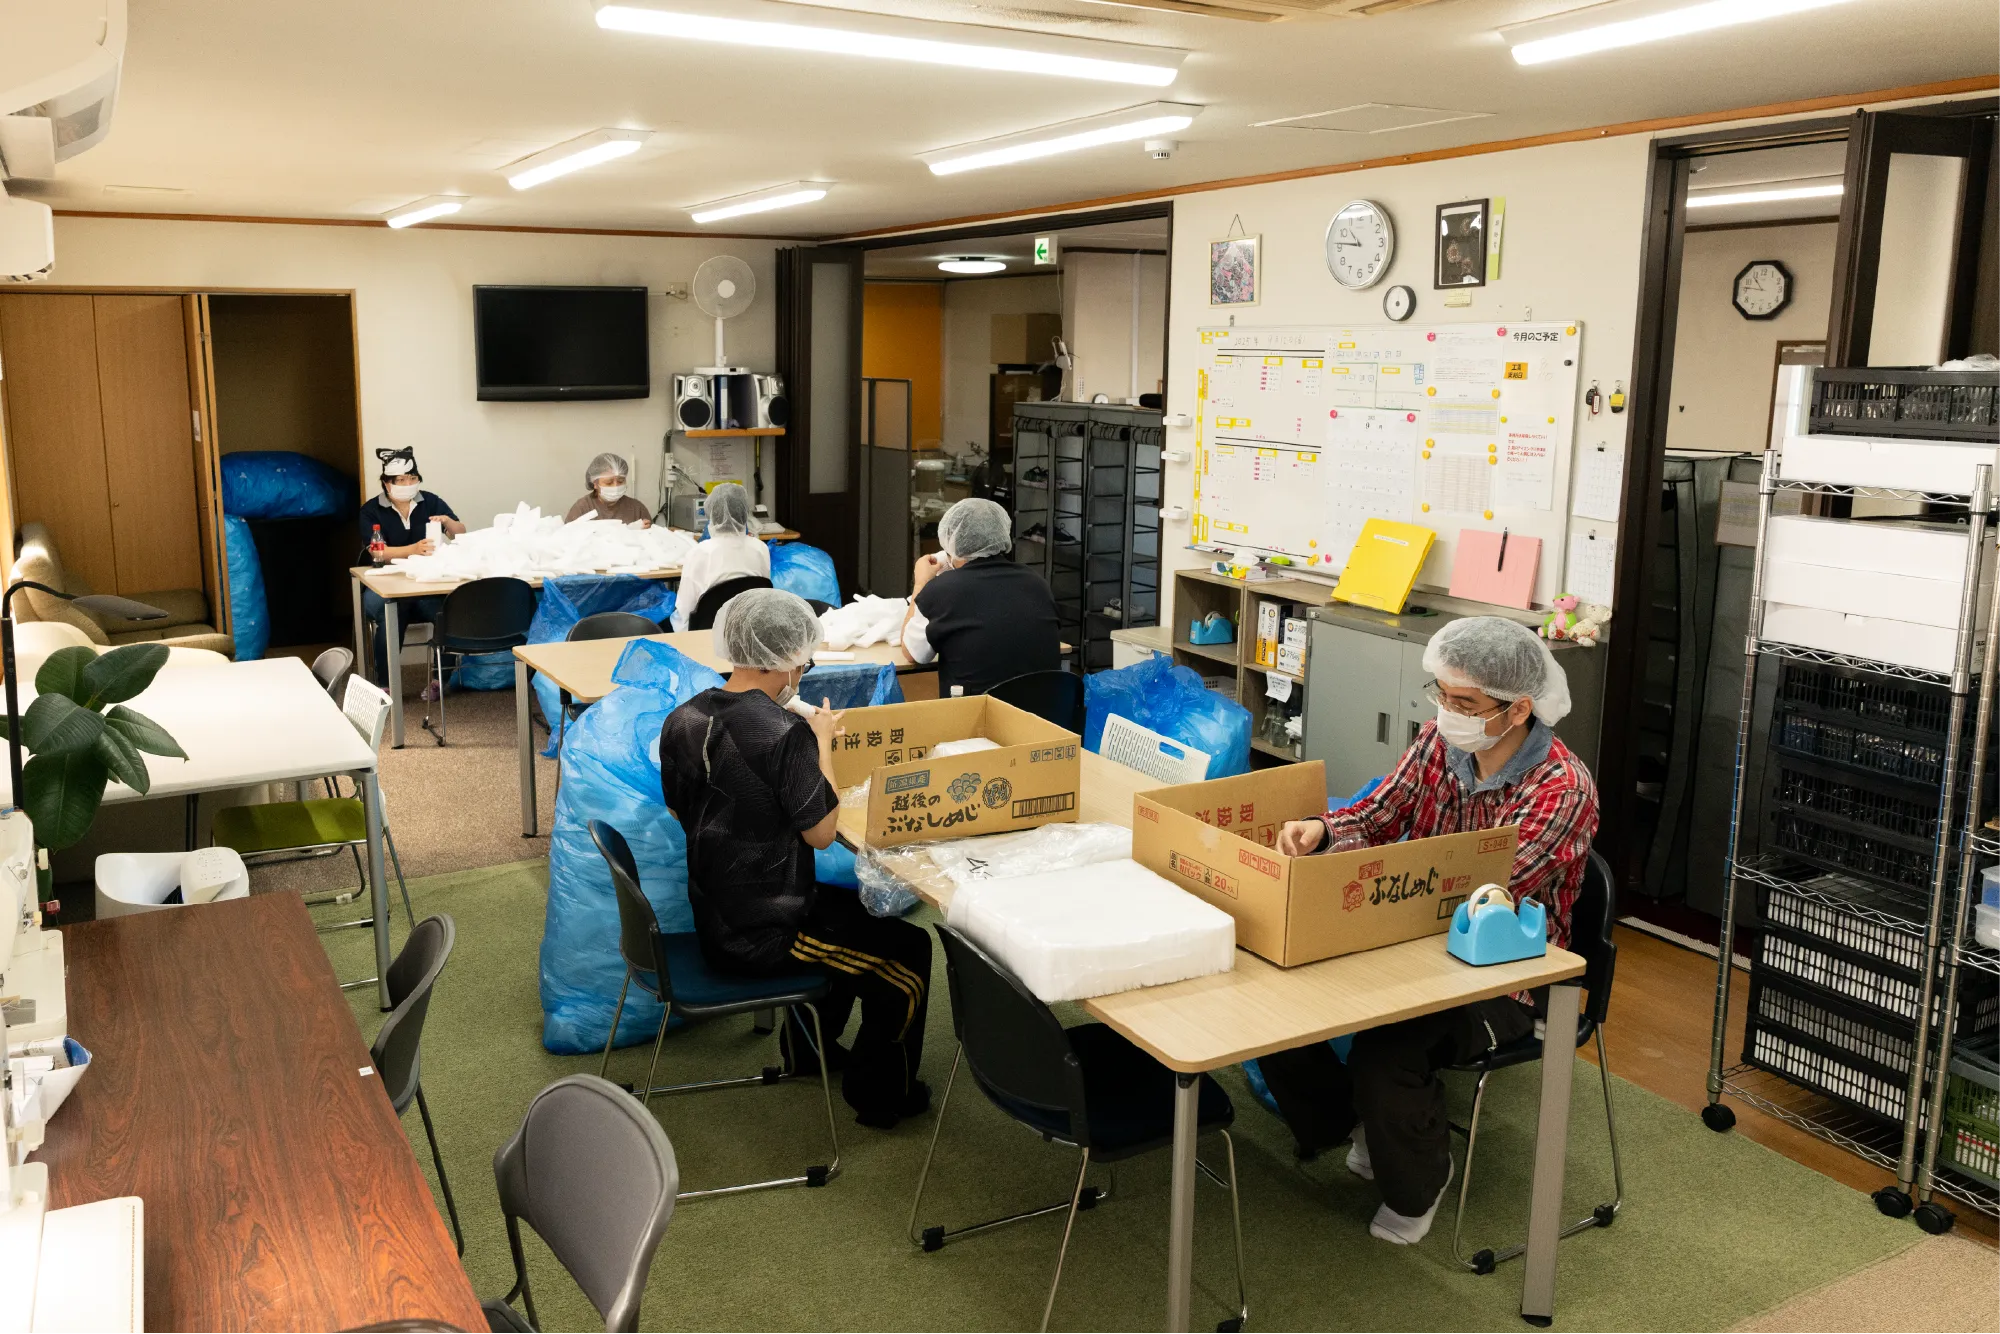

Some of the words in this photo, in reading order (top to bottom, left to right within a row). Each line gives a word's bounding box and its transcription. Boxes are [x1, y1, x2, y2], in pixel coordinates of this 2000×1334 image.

[1340, 228, 1348, 238] 10
[1374, 224, 1381, 234] 2
[1336, 243, 1342, 252] 9
[1378, 238, 1384, 248] 3
[1340, 256, 1346, 266] 8
[1374, 253, 1380, 262] 4
[1348, 266, 1352, 275] 7
[1356, 268, 1363, 278] 6
[1368, 264, 1374, 274] 5
[1513, 332, 1559, 342] 今月のご予定
[891, 792, 941, 813] 越後の
[882, 804, 981, 836] ぶなしめじ
[1369, 866, 1439, 906] ぶなしめじ
